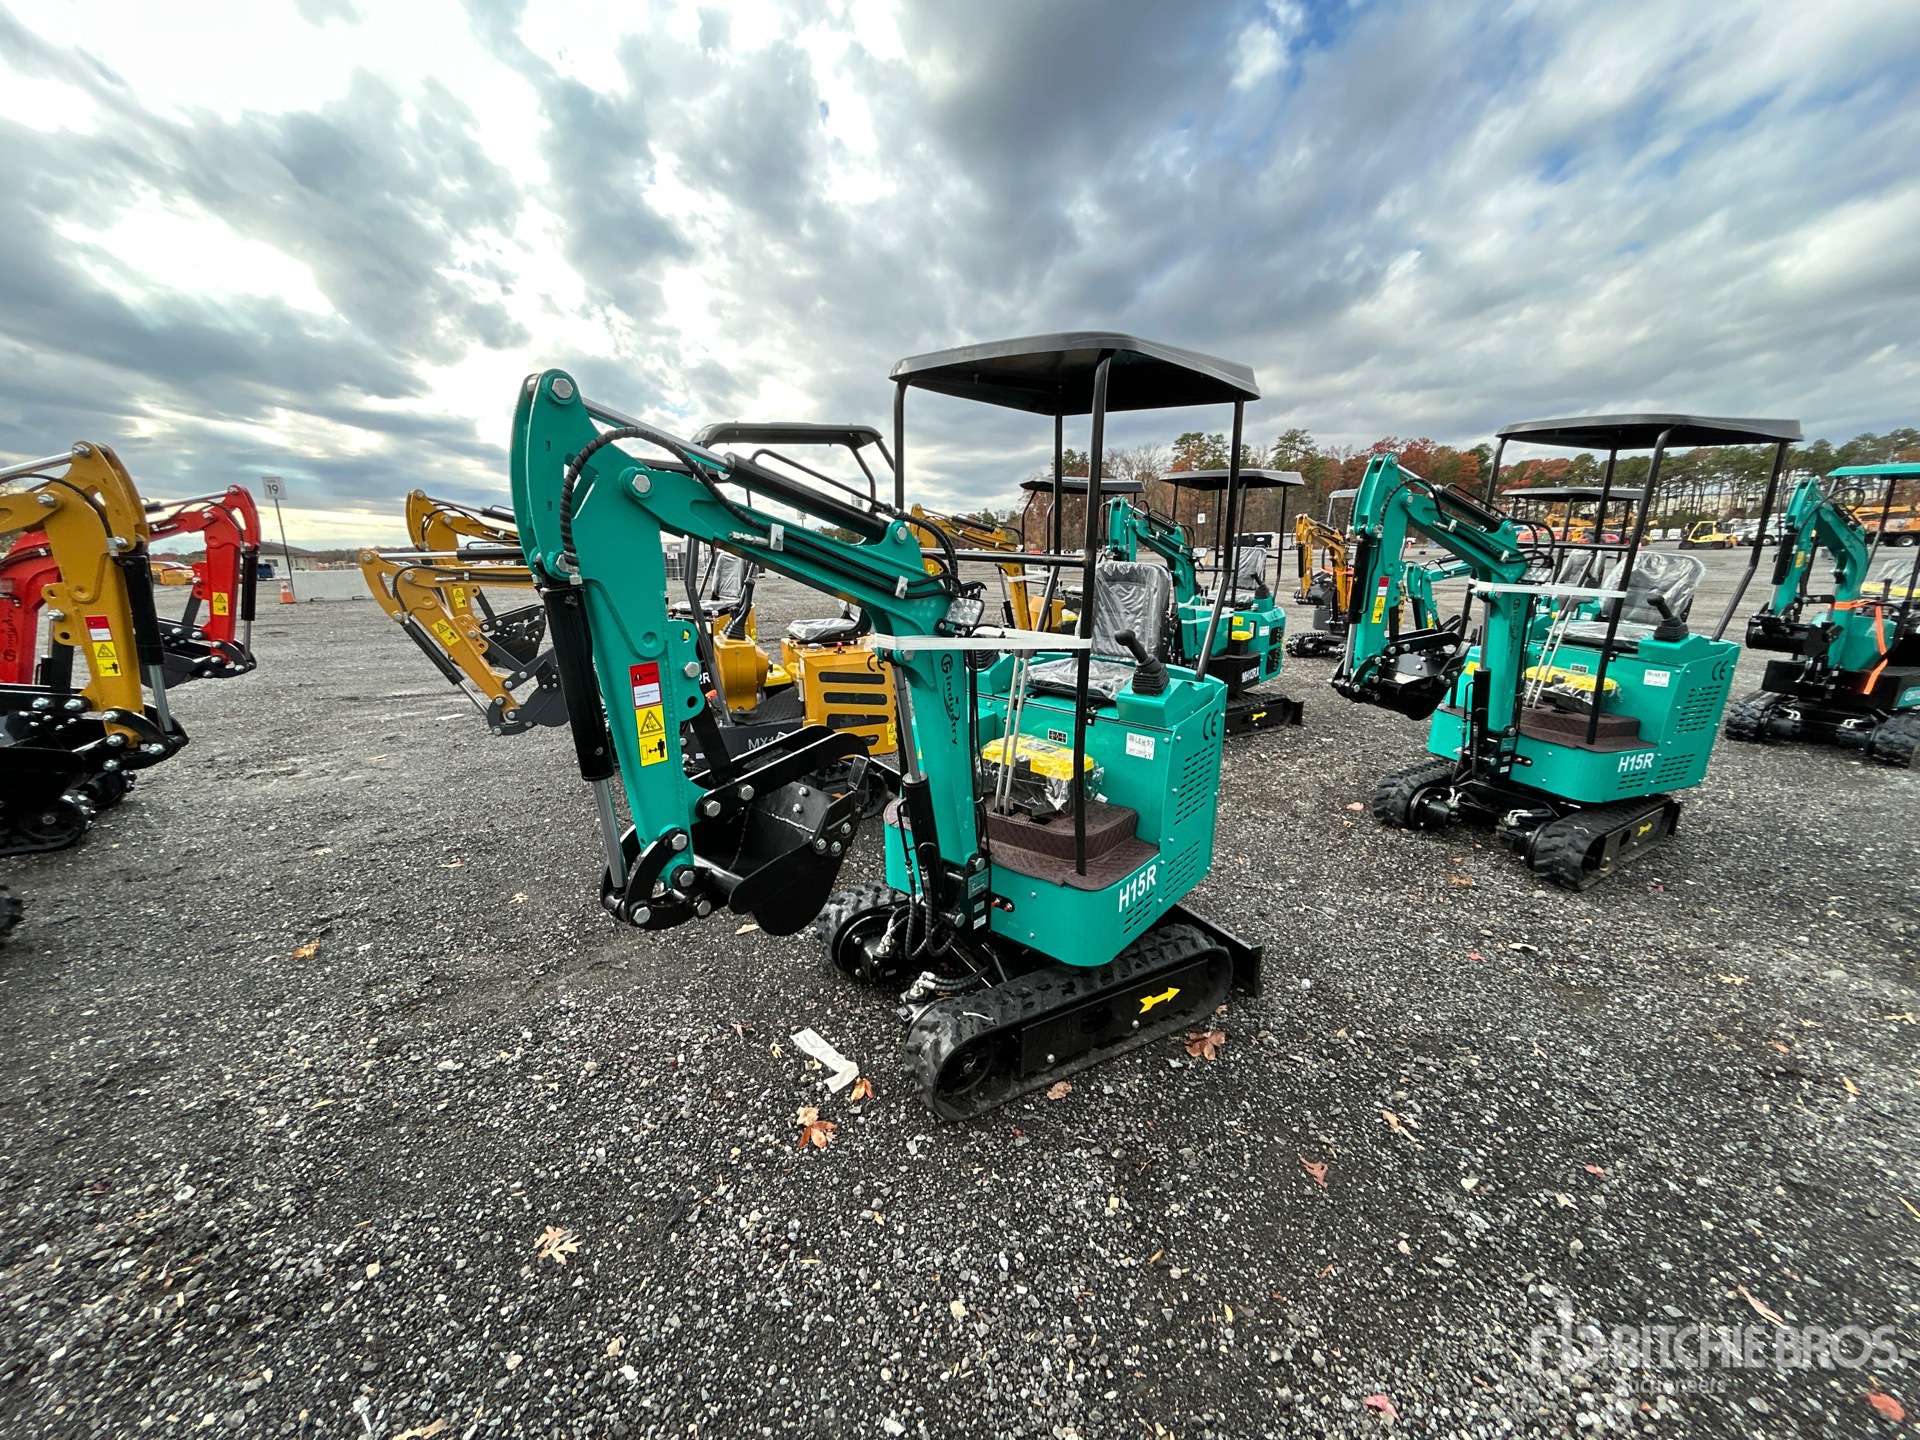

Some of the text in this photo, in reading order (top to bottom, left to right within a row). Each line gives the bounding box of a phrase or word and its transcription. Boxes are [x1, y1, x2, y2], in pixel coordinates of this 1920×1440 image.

[267, 484, 279, 494] 19
[1712, 660, 1730, 681] CE
[1203, 709, 1219, 740] CE
[1617, 753, 1654, 773] H15R
[1118, 864, 1157, 912] H15R
